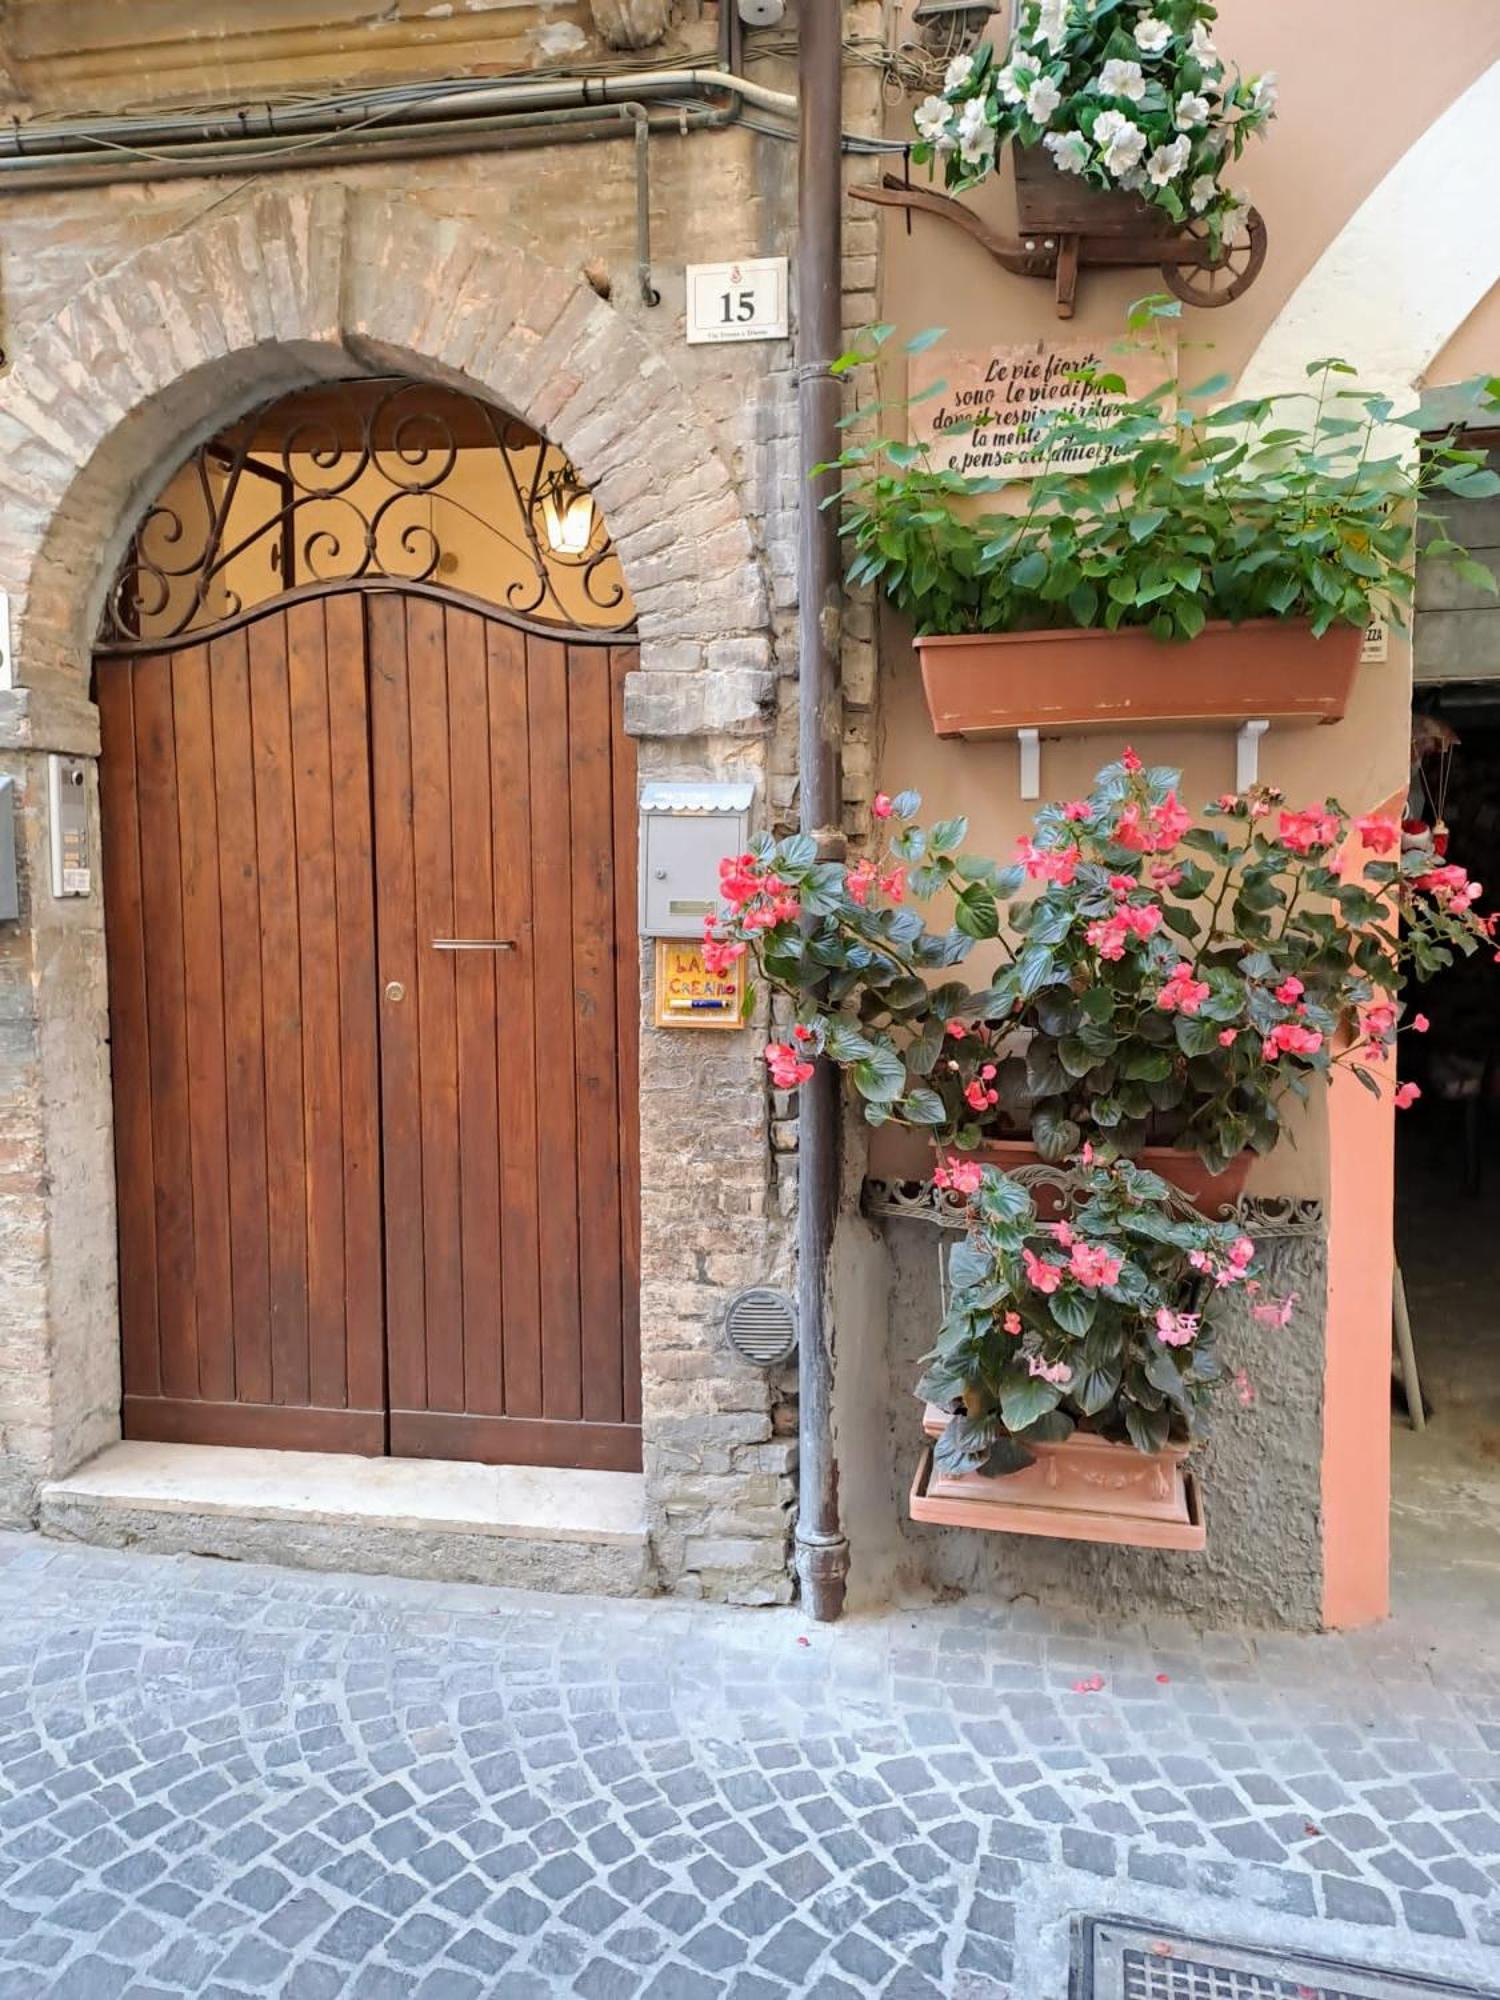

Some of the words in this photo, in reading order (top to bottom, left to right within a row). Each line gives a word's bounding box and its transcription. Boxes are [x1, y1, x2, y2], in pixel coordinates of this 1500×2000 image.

[720, 290, 755, 323] 15
[985, 359, 1008, 383] Le
[1012, 360, 1041, 380] vie
[955, 388, 995, 407] sono
[1029, 383, 1058, 402] vie
[972, 428, 987, 448] la
[993, 428, 1041, 448] mente
[949, 455, 958, 470] e
